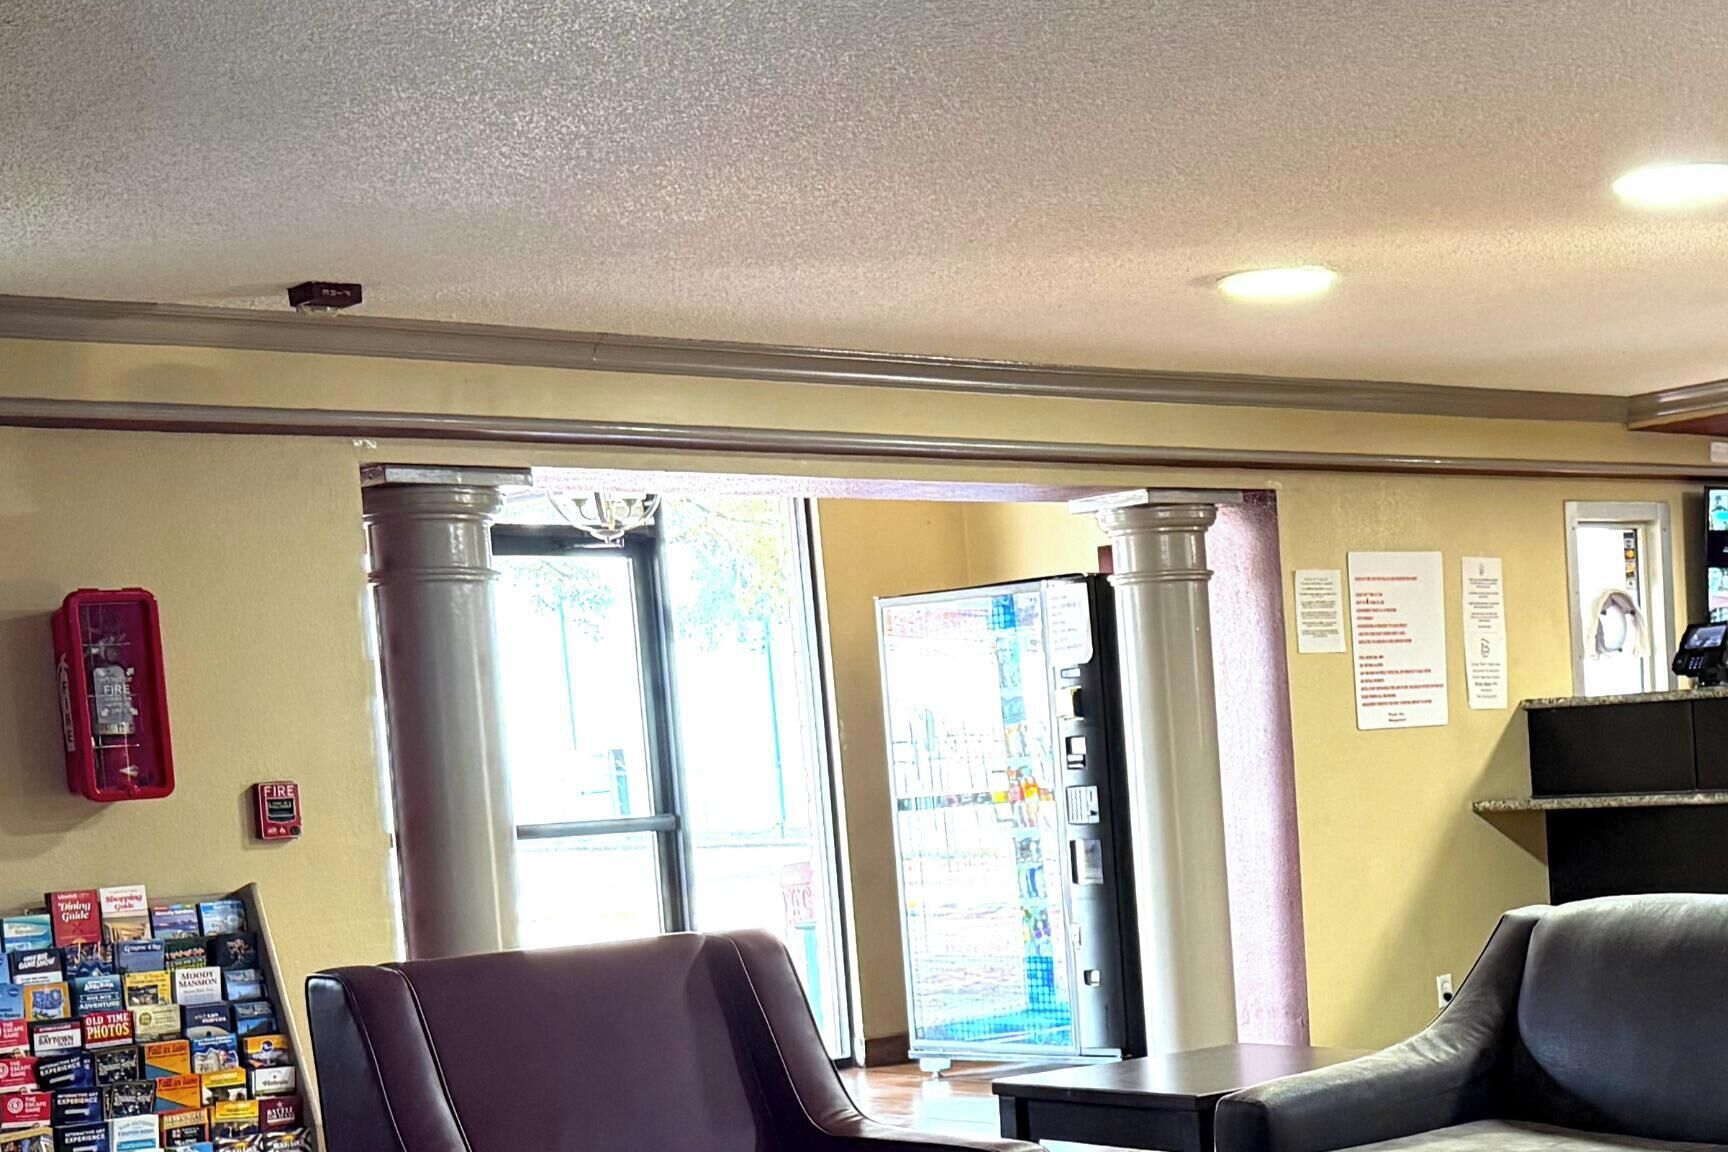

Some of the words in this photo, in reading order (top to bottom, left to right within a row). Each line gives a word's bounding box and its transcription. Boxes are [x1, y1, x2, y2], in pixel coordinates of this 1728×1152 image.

[104, 684, 130, 695] FIRE
[264, 785, 294, 797] FIRE
[105, 893, 143, 905] Shopping
[58, 901, 91, 911] Dining
[61, 911, 89, 922] Guide
[181, 971, 214, 980] MOODY
[179, 979, 217, 988] MANSION
[79, 1001, 120, 1009] ADVENTURE
[85, 1016, 104, 1026] OLD
[107, 1013, 129, 1023] TIME
[86, 1022, 130, 1040] PHOTOS
[40, 1062, 80, 1076] EXPERIENCE
[57, 1097, 98, 1105] EXPERIENCE
[65, 1133, 105, 1144] EXPERIENCE
